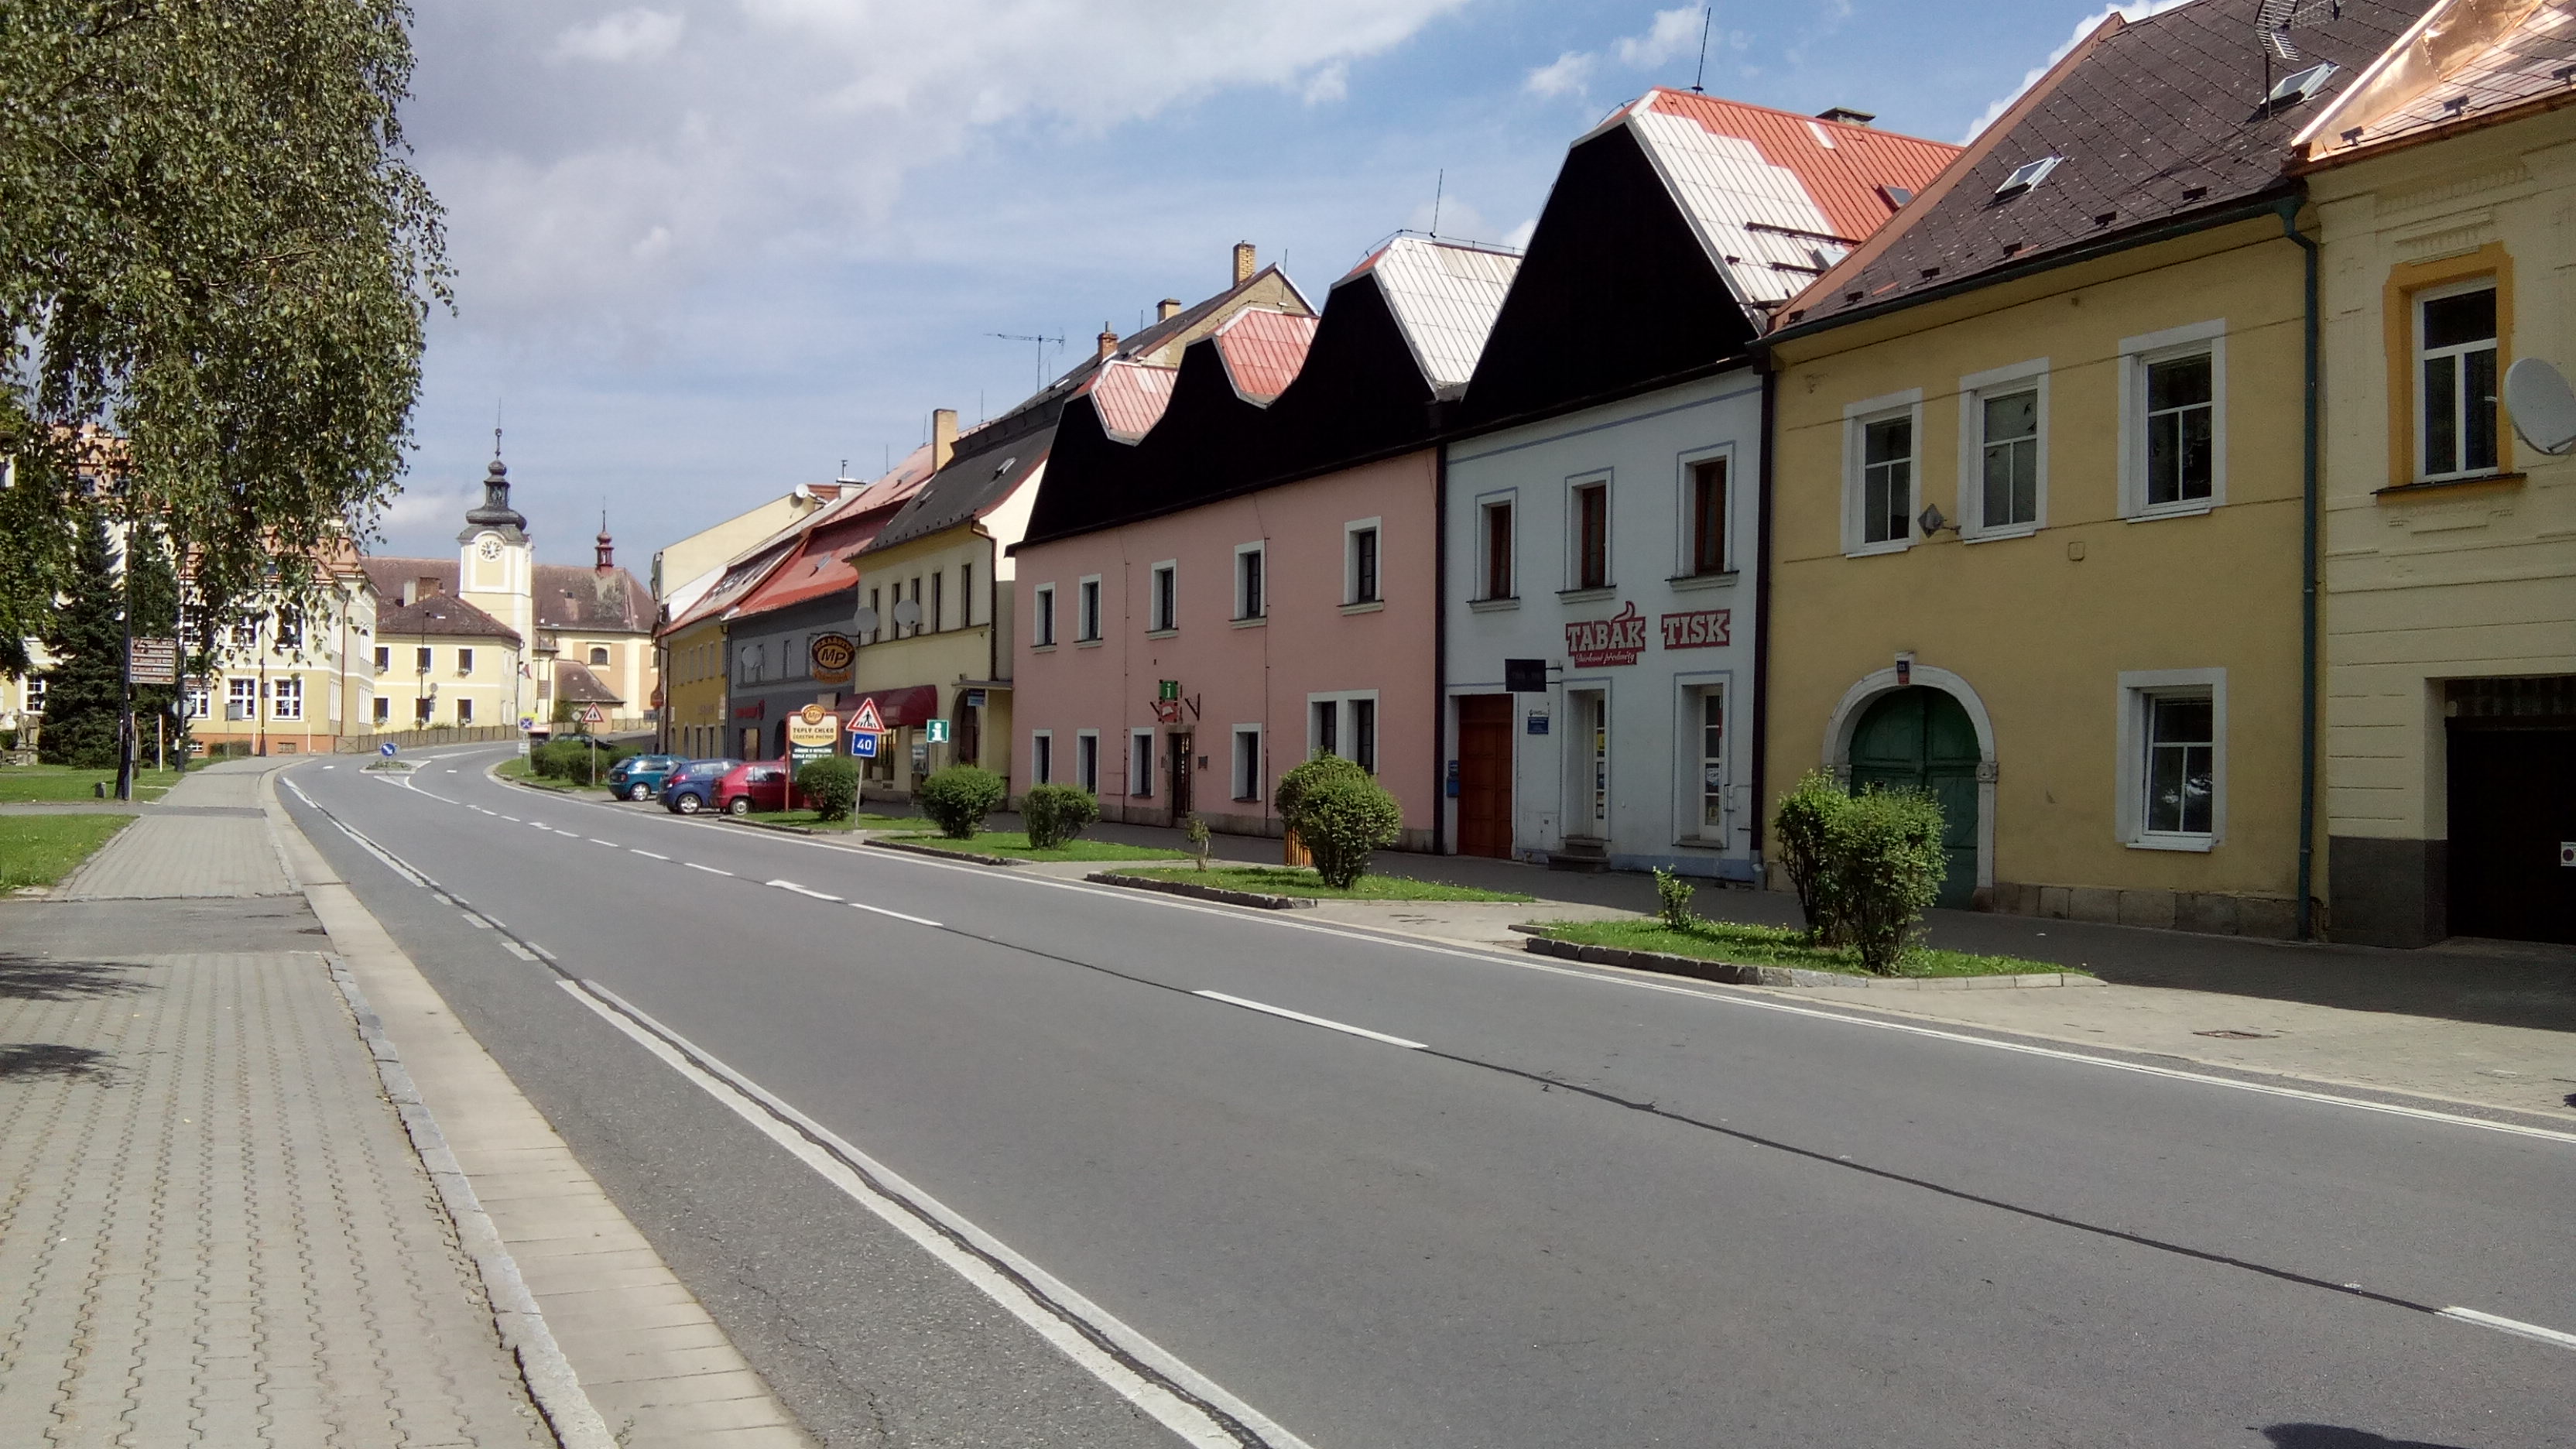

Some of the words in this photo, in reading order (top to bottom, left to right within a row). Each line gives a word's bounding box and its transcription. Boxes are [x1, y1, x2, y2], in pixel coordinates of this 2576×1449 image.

[1567, 604, 1643, 652] TABÁK
[1664, 613, 1728, 646] TISK
[821, 649, 847, 664] MP
[857, 738, 872, 750] 40
